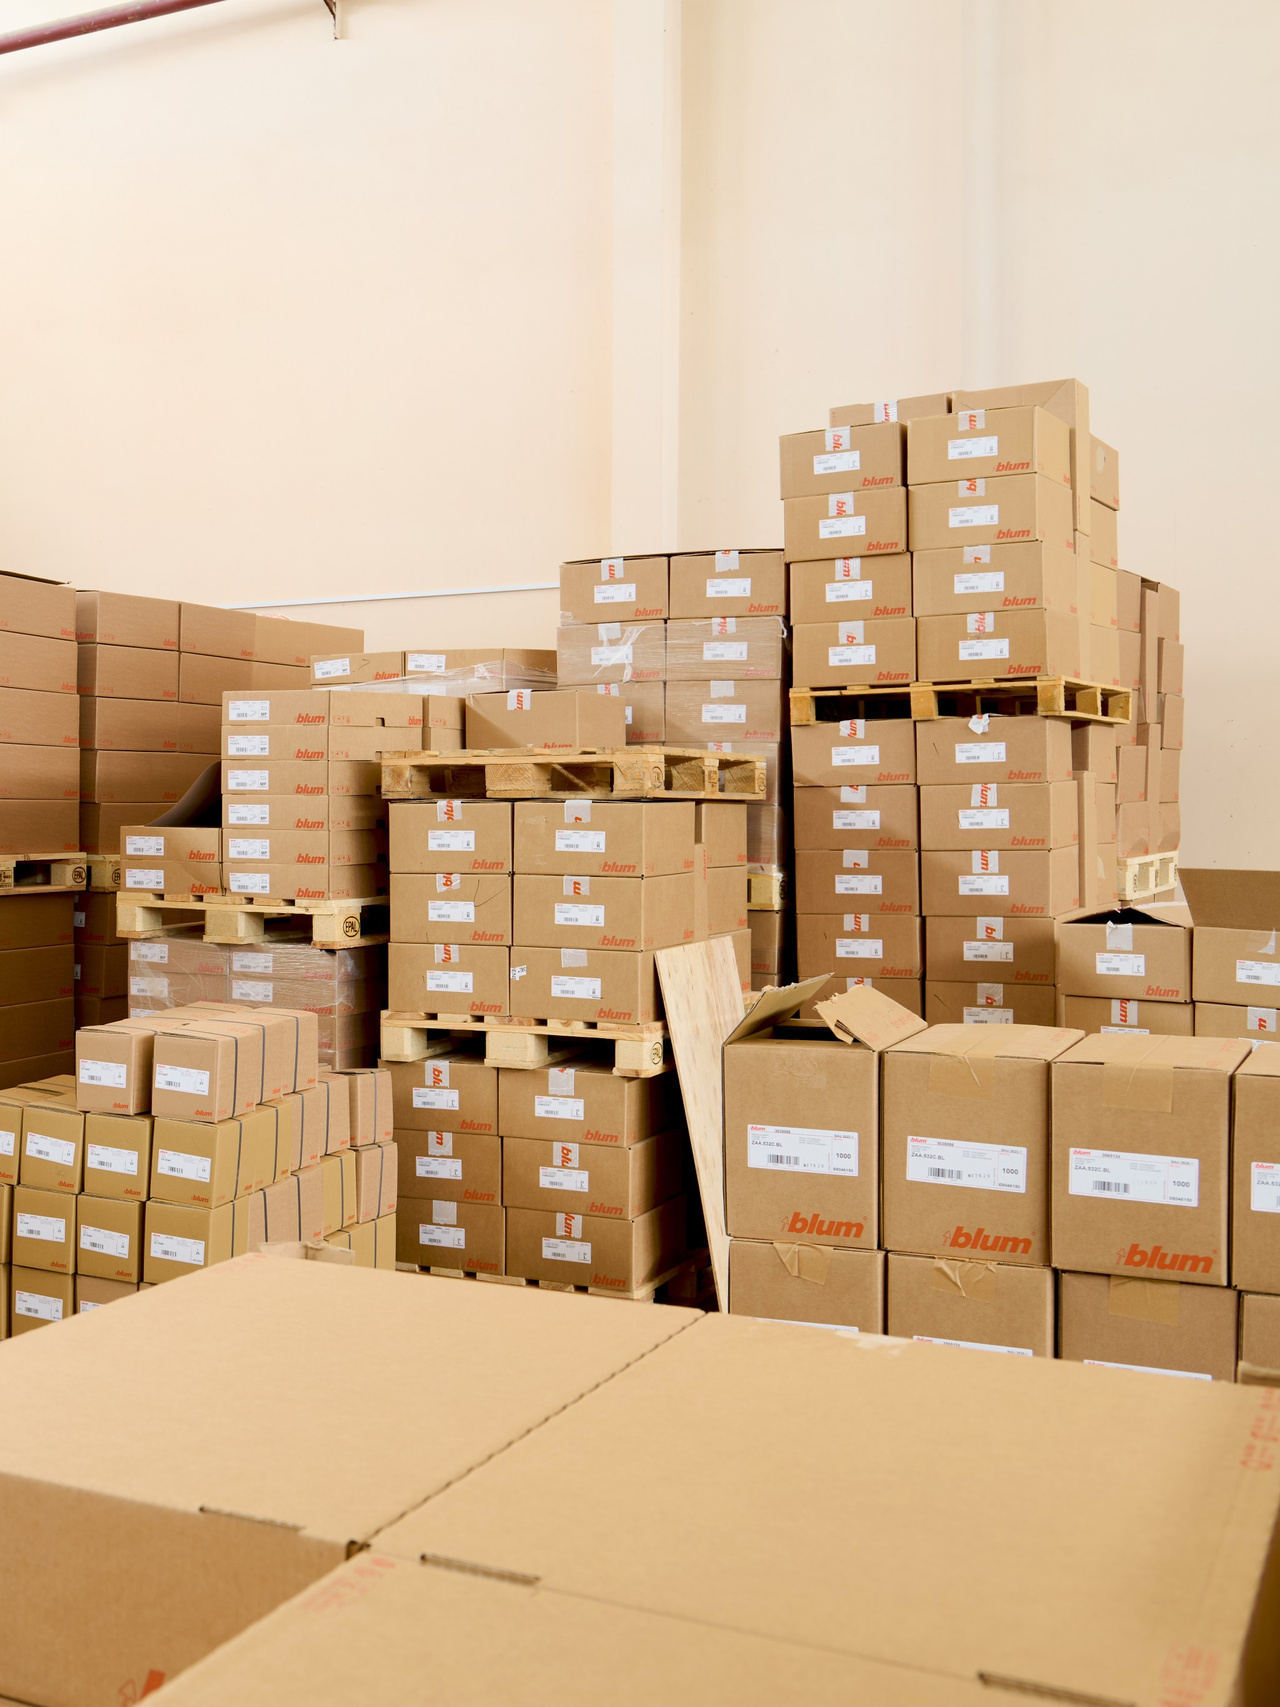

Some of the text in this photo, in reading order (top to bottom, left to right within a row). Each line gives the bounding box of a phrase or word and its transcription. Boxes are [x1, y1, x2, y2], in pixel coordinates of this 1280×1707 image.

[996, 462, 1030, 472] blum
[862, 477, 894, 487] blum
[996, 529, 1030, 539] blum
[867, 542, 898, 551] blum
[1003, 596, 1037, 607] blum
[632, 608, 663, 617] blum
[747, 603, 778, 612] blum
[874, 606, 906, 616] blum
[1007, 664, 1041, 674] blum
[375, 672, 399, 680] blum
[877, 671, 909, 680] blum
[296, 713, 325, 723] blum
[296, 749, 324, 759] blum
[877, 772, 910, 781] blum
[1007, 770, 1042, 780] blum
[295, 784, 324, 794] blum
[296, 819, 324, 828] blum
[877, 837, 909, 848] blum
[1011, 837, 1045, 846] blum
[189, 850, 215, 860] blum
[296, 854, 325, 864] blum
[472, 859, 504, 869] blum
[602, 862, 636, 872] blum
[74, 870, 84, 881] EPAL
[190, 884, 219, 894] blum
[296, 888, 325, 898] blum
[880, 902, 912, 912] blum
[1009, 904, 1044, 915] blum
[345, 921, 358, 933] EPAL
[472, 931, 504, 941] blum
[601, 935, 635, 947] blum
[880, 967, 912, 976] blum
[1014, 971, 1049, 981] blum
[1145, 986, 1180, 998] blum
[470, 1001, 502, 1012] blum
[598, 1008, 632, 1020] blum
[460, 1120, 492, 1131] blum
[583, 1130, 618, 1142] blum
[1172, 1180, 1191, 1188] 1000
[463, 1190, 494, 1200] blum
[589, 1202, 623, 1215] blum
[788, 1212, 864, 1238] blum
[949, 1226, 1032, 1254] blum
[1124, 1243, 1213, 1273] blum
[467, 1259, 497, 1270] blum
[592, 1274, 625, 1287] blum
